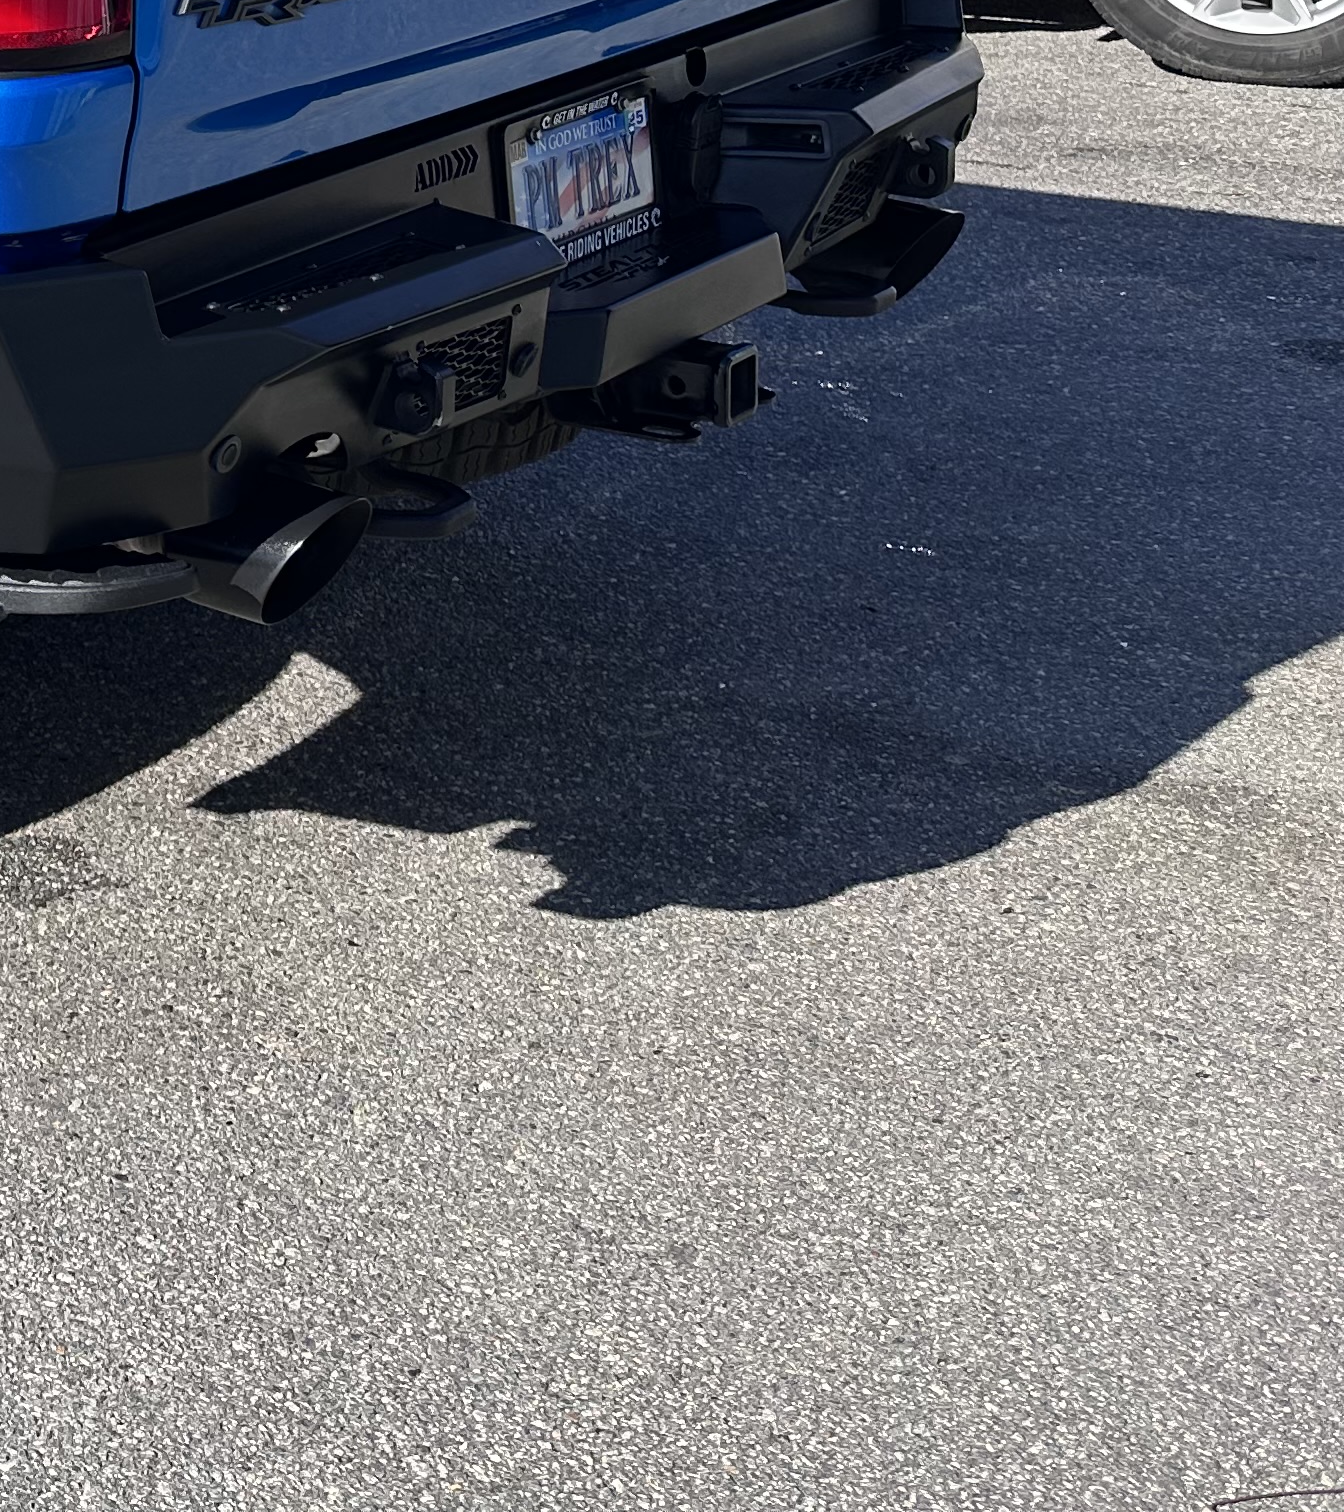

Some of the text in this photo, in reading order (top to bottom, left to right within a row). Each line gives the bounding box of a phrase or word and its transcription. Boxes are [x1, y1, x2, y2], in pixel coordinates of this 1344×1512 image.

[534, 112, 618, 155] IN GOD WE TRUST
[414, 153, 454, 192] ADD
[567, 131, 641, 219] TREX
[567, 230, 602, 262] RIDING
[603, 212, 650, 248] VEHICLES
